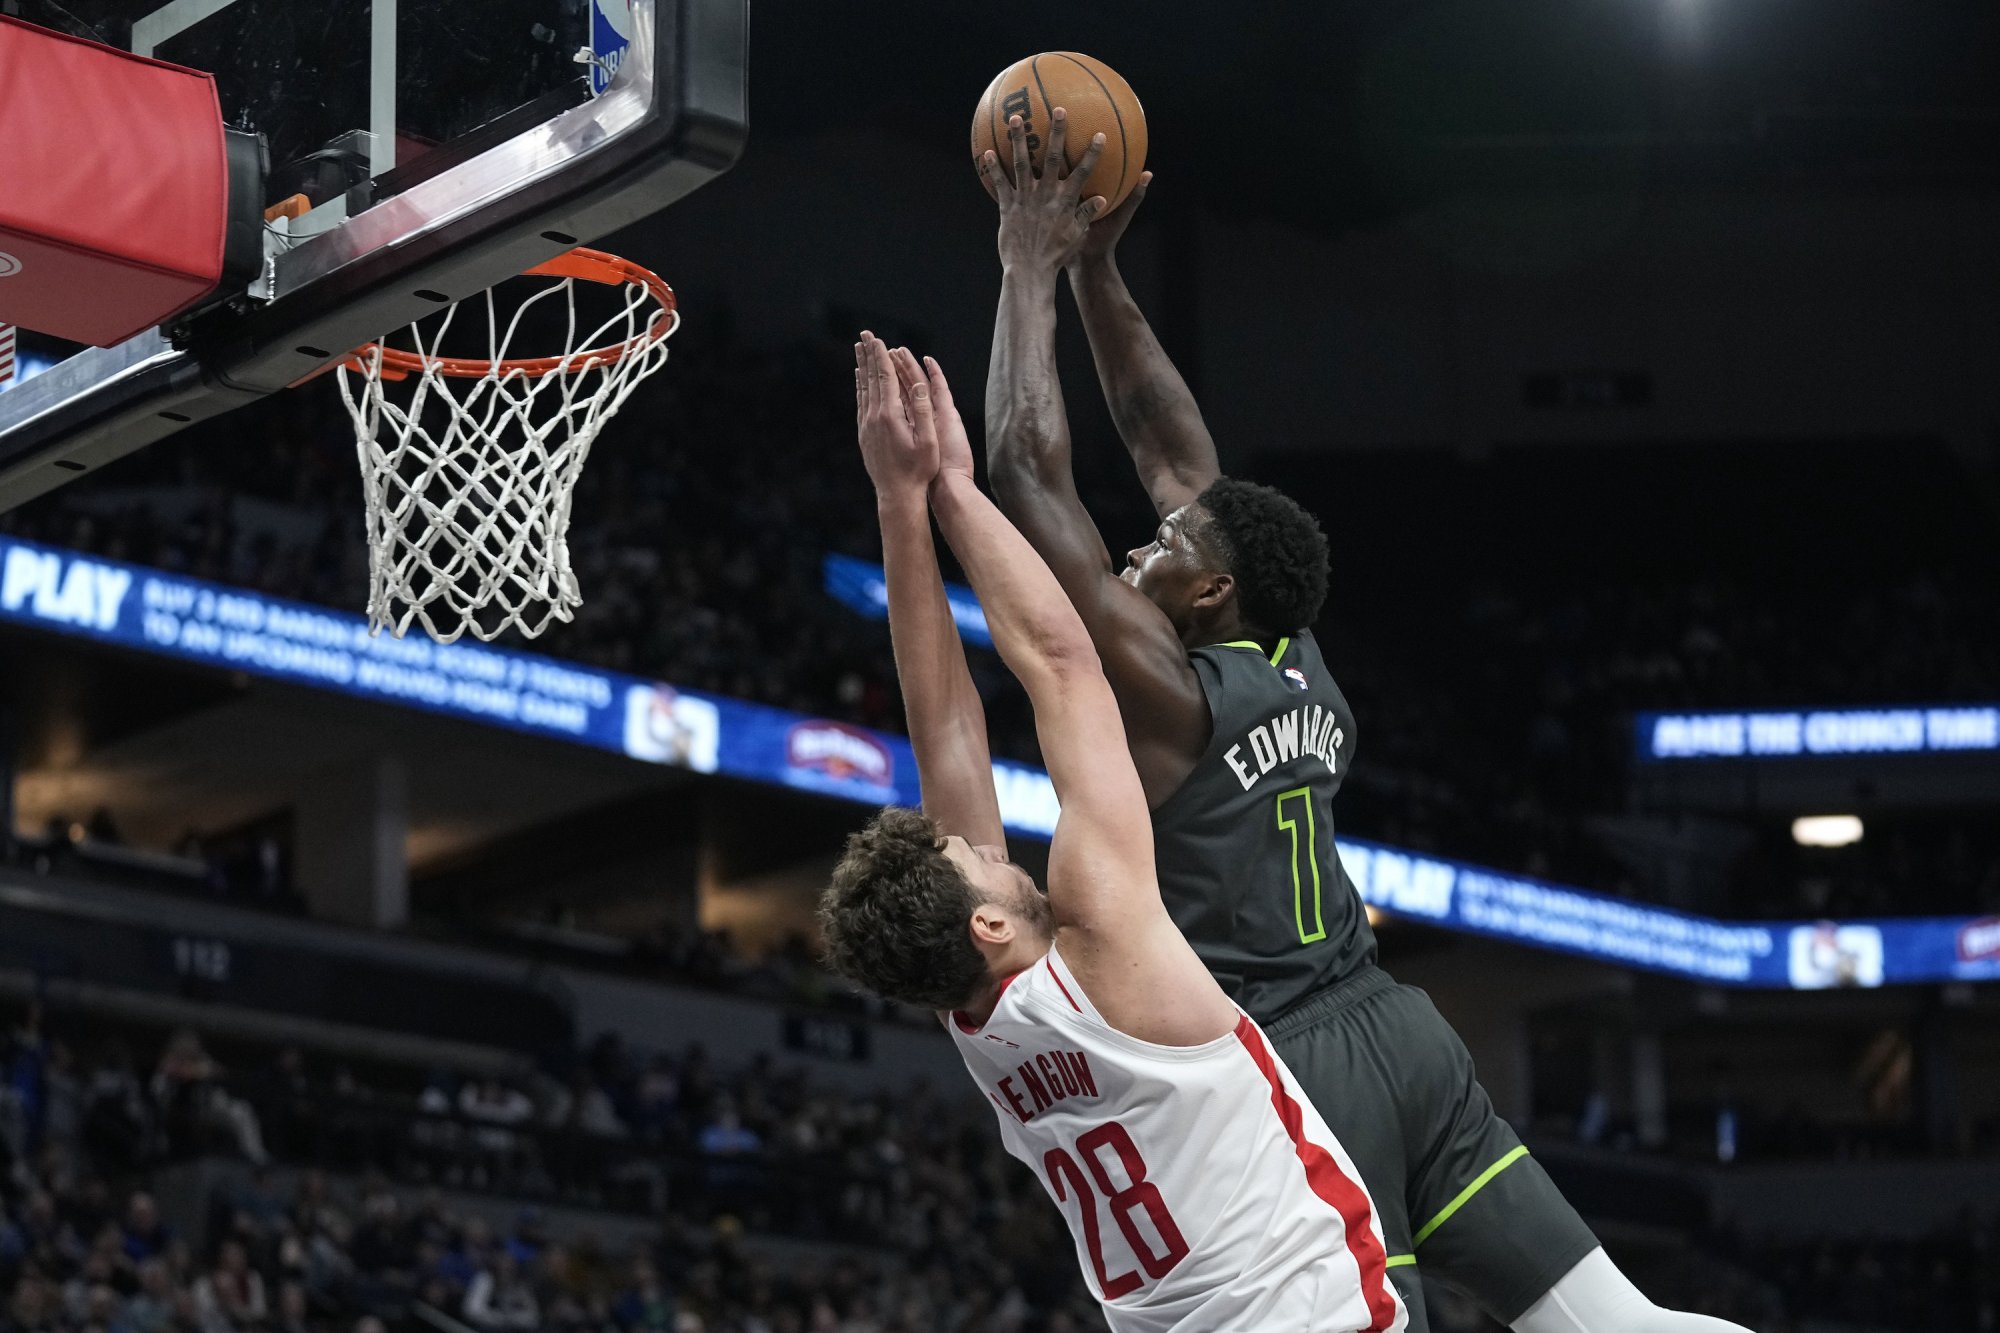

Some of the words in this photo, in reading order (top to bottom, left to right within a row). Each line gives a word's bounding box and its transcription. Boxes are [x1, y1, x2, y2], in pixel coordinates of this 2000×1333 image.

[1, 546, 132, 631] PLAY
[1223, 704, 1344, 791] EDWARDS
[1748, 713, 1802, 753] THE
[1276, 786, 1326, 944] 1
[1373, 848, 1456, 918] PLAY
[990, 1050, 1099, 1127] ENGUN
[1043, 1120, 1191, 1301] 28
